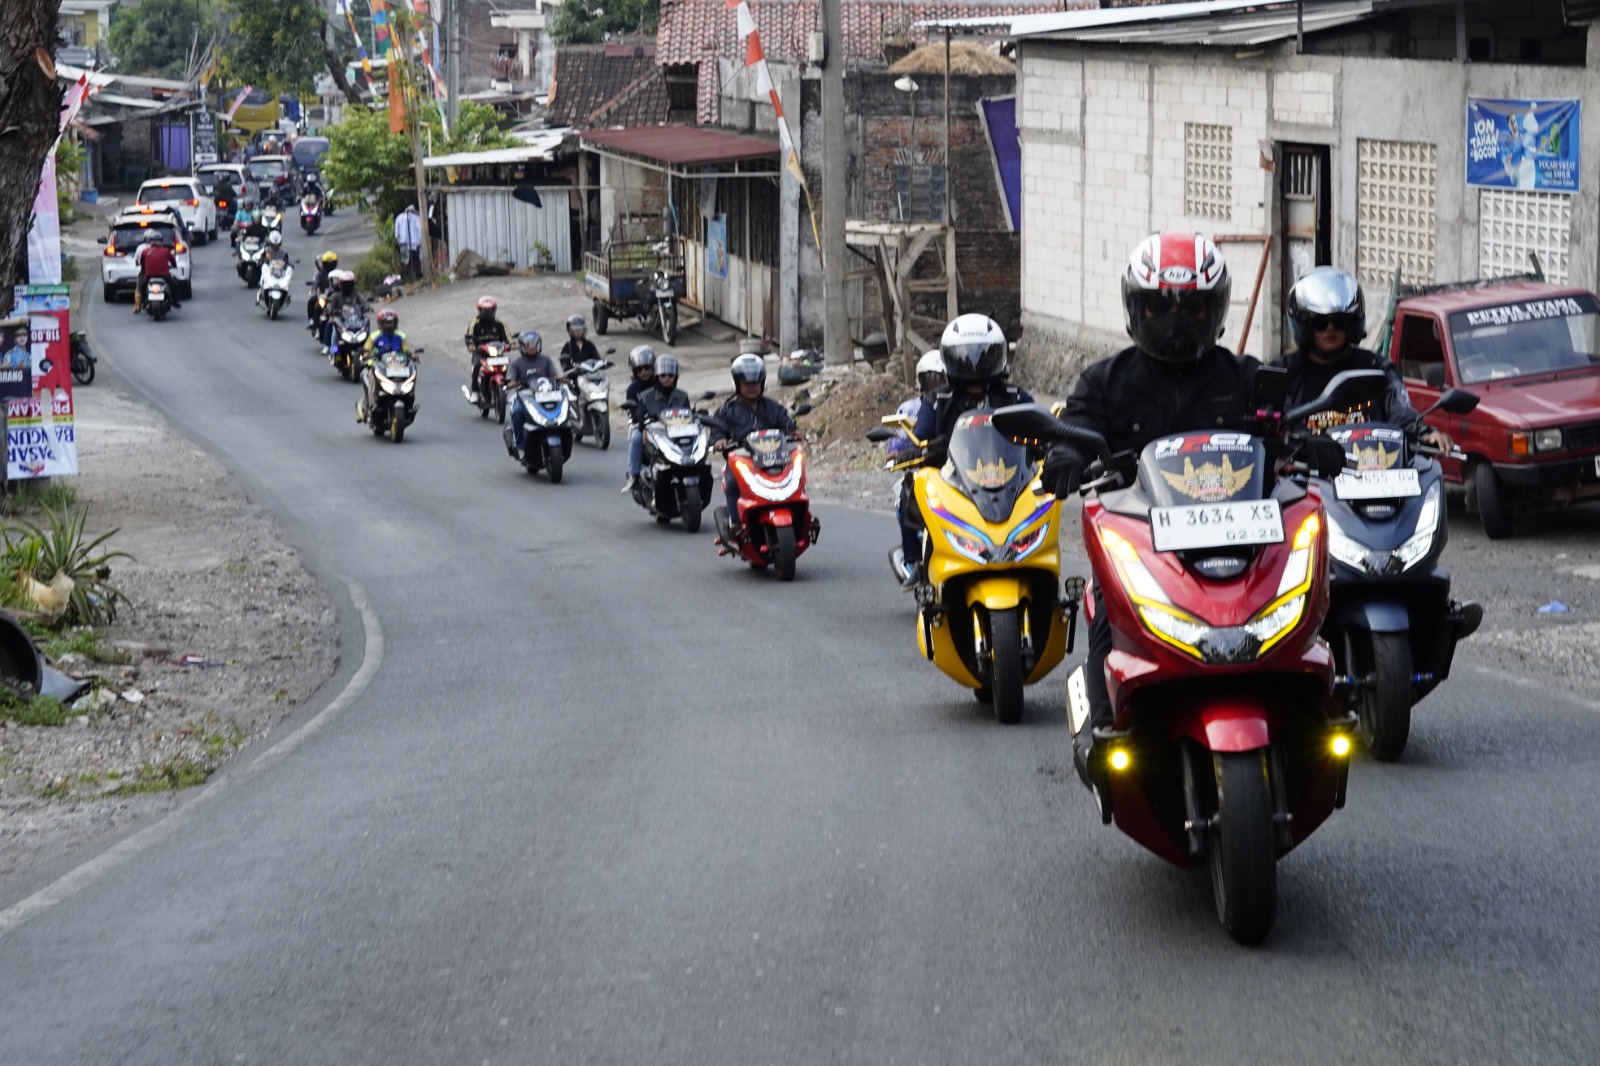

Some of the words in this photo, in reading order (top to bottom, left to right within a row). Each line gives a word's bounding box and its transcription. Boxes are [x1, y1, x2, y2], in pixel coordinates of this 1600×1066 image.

[1473, 118, 1495, 137] ION
[1470, 129, 1499, 148] TAHAN
[1155, 433, 1251, 455] HPCI
[1159, 511, 1171, 528] H
[1186, 507, 1234, 526] 3634
[1251, 504, 1274, 520] XS
[1203, 558, 1240, 569] HONDA
